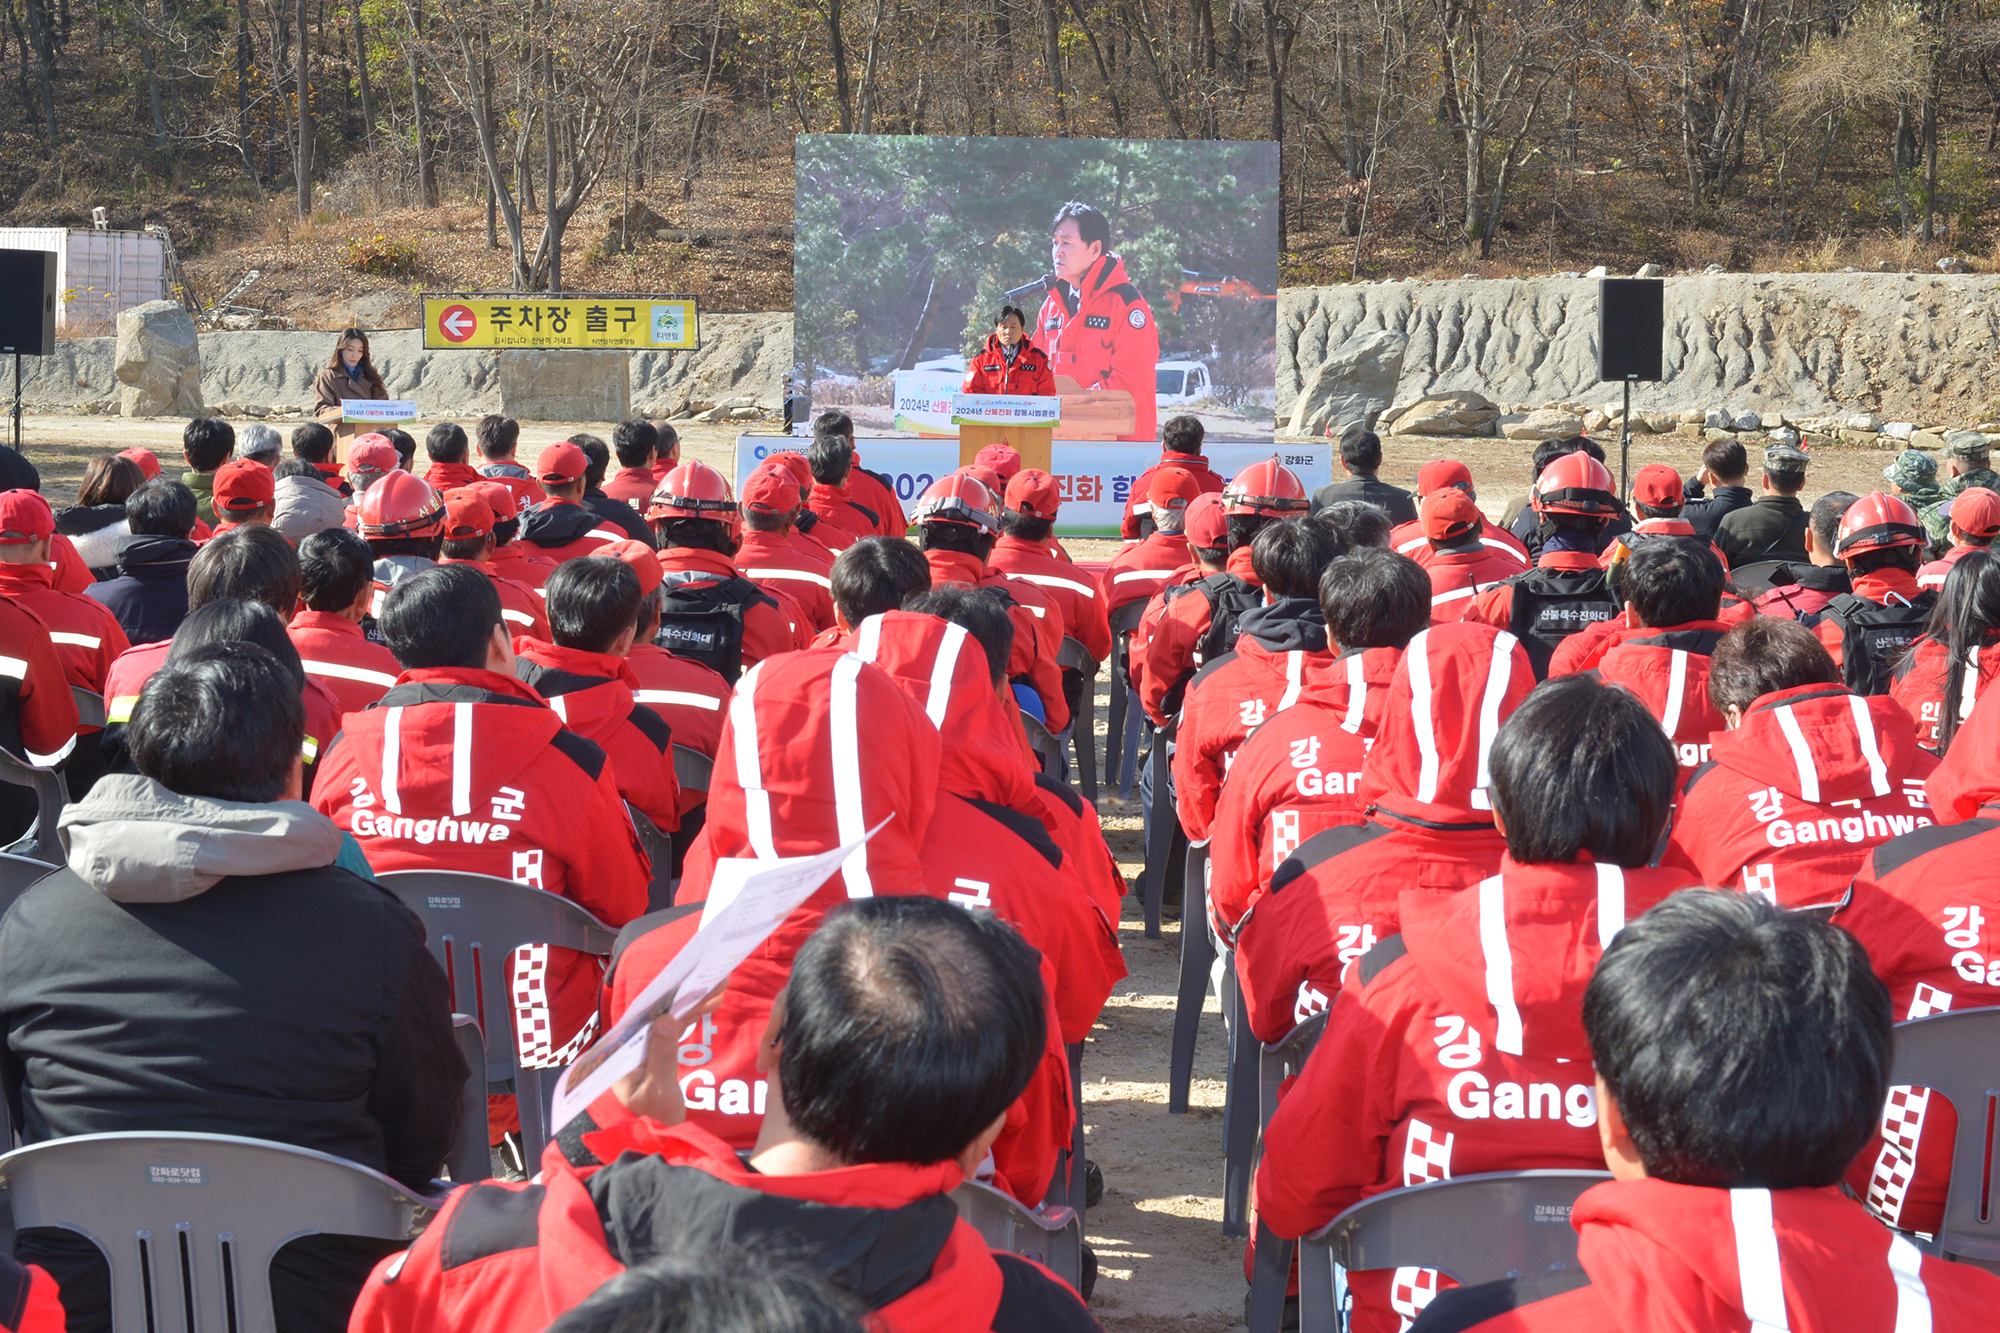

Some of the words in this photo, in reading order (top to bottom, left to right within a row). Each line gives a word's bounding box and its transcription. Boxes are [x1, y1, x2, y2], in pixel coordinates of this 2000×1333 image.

[490, 305, 571, 334] 주차장
[586, 305, 636, 333] 출구
[656, 331, 679, 341] 티앤림
[900, 398, 930, 413] 2024년
[955, 406, 983, 416] 2024년
[984, 407, 1012, 417] 산불진화
[1014, 408, 1056, 418] 합동시범훈련
[1284, 455, 1314, 466] 강화군
[1541, 609, 1609, 622] 산불특수진화대
[1289, 735, 1321, 769] 강
[491, 786, 526, 821] 군
[1748, 786, 1784, 823] 강
[351, 809, 510, 845] Ganghwa
[1941, 905, 1985, 949] 강
[1446, 1070, 1599, 1128] Gang
[150, 1166, 200, 1178] 강화로닷컴
